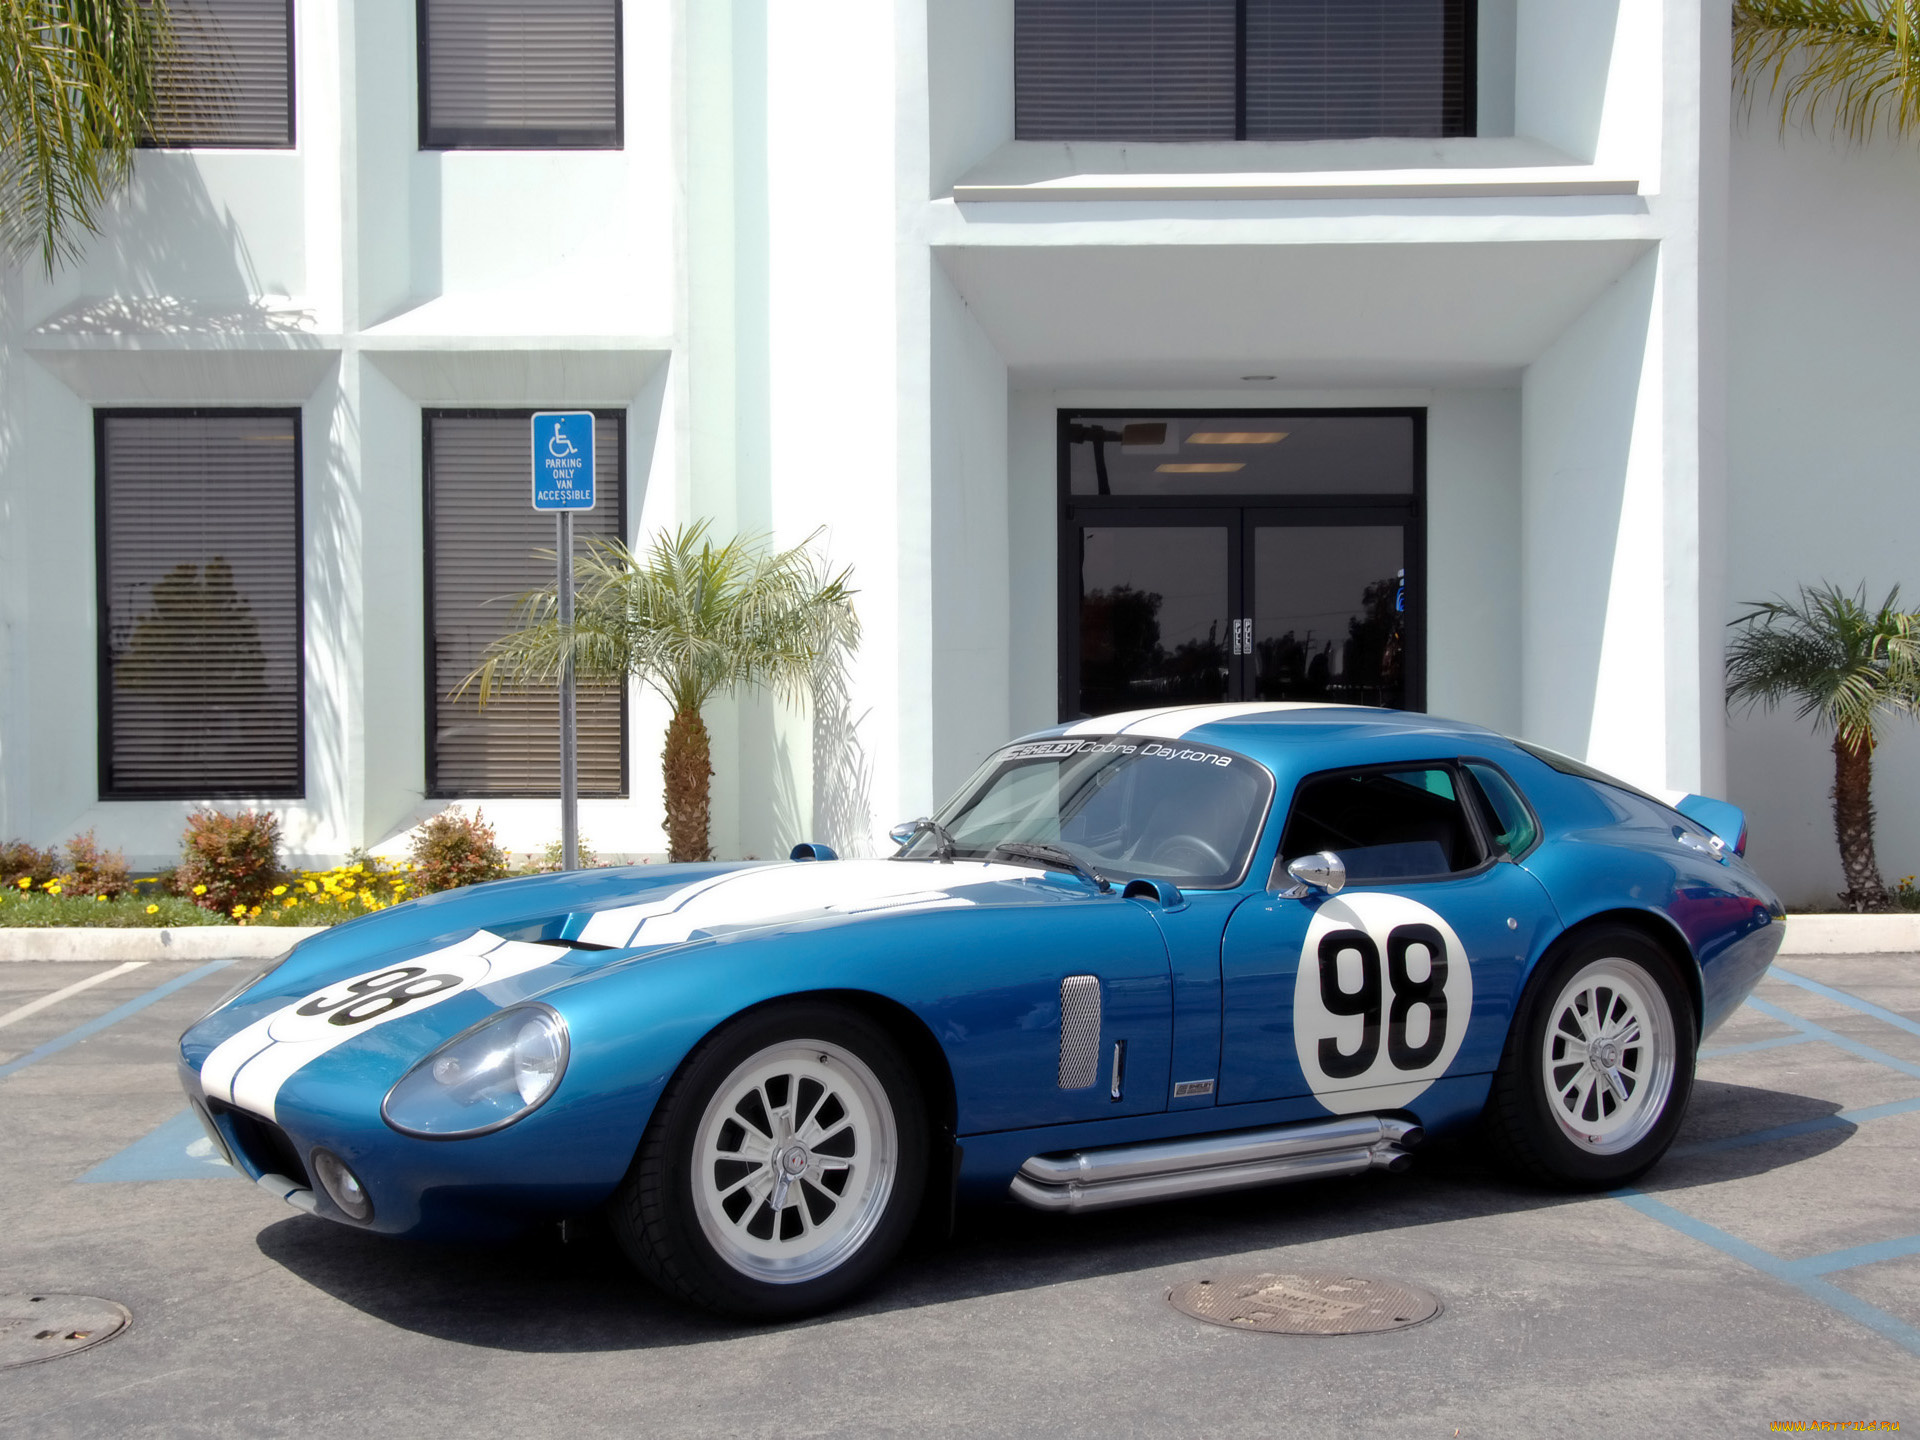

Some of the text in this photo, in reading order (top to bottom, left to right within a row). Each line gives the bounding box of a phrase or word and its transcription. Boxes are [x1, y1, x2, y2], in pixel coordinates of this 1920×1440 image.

[545, 458, 582, 468] PARKING
[553, 469, 575, 479] ONLY
[556, 480, 573, 489] VAN
[537, 490, 591, 500] ACCESSIBLE
[1016, 741, 1233, 767] SHELBY Cobra Daytona
[296, 967, 464, 1026] 98
[1318, 923, 1448, 1078] 98
